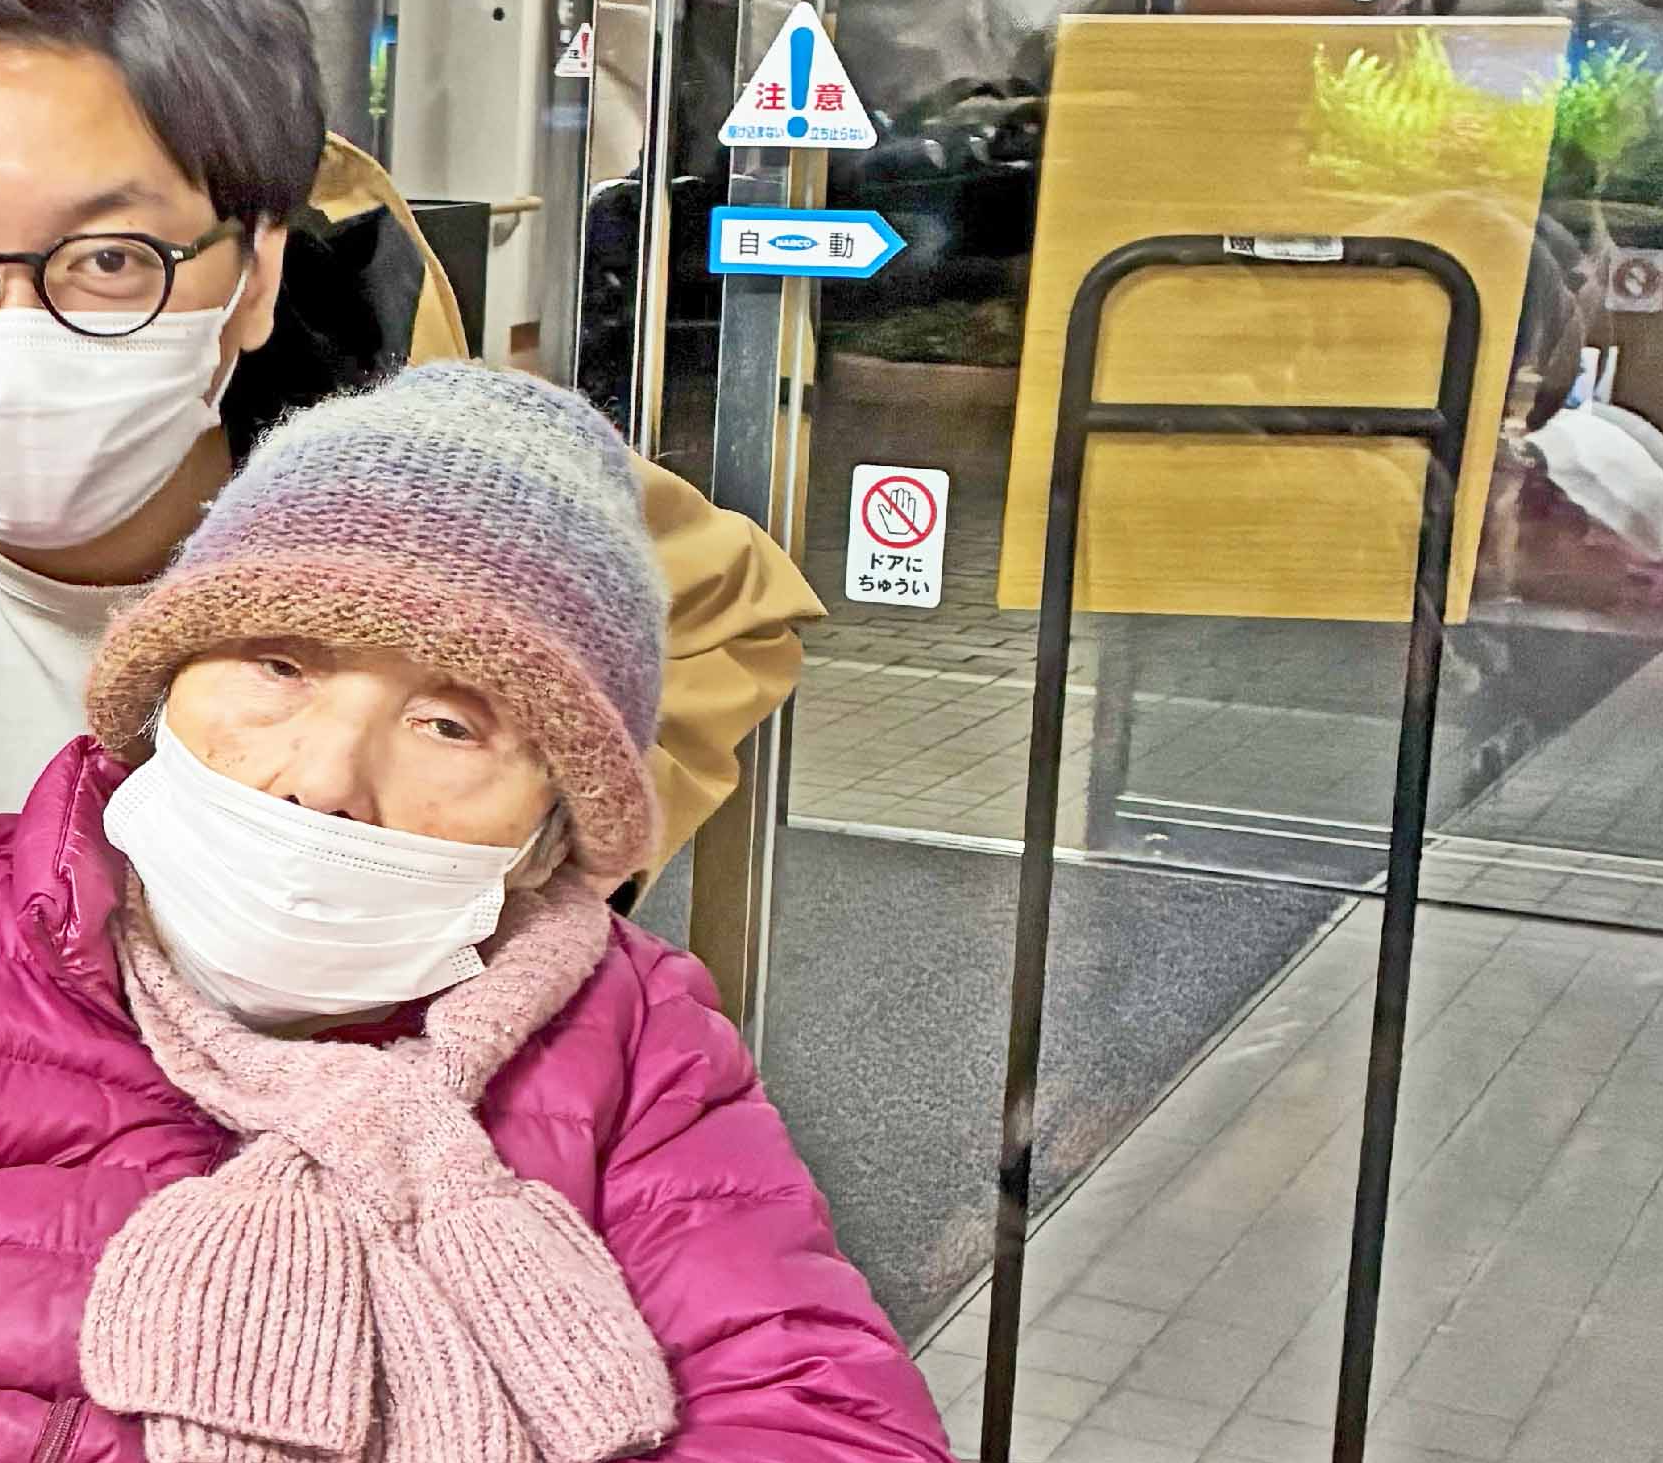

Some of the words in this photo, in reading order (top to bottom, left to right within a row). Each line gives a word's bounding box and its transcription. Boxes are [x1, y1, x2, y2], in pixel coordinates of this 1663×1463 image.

[755, 82, 786, 110] 注
[814, 83, 846, 112] 意
[739, 229, 760, 256] 自
[828, 232, 855, 259] 動
[870, 552, 924, 573] ドアに
[858, 574, 930, 596] ちゅうい
